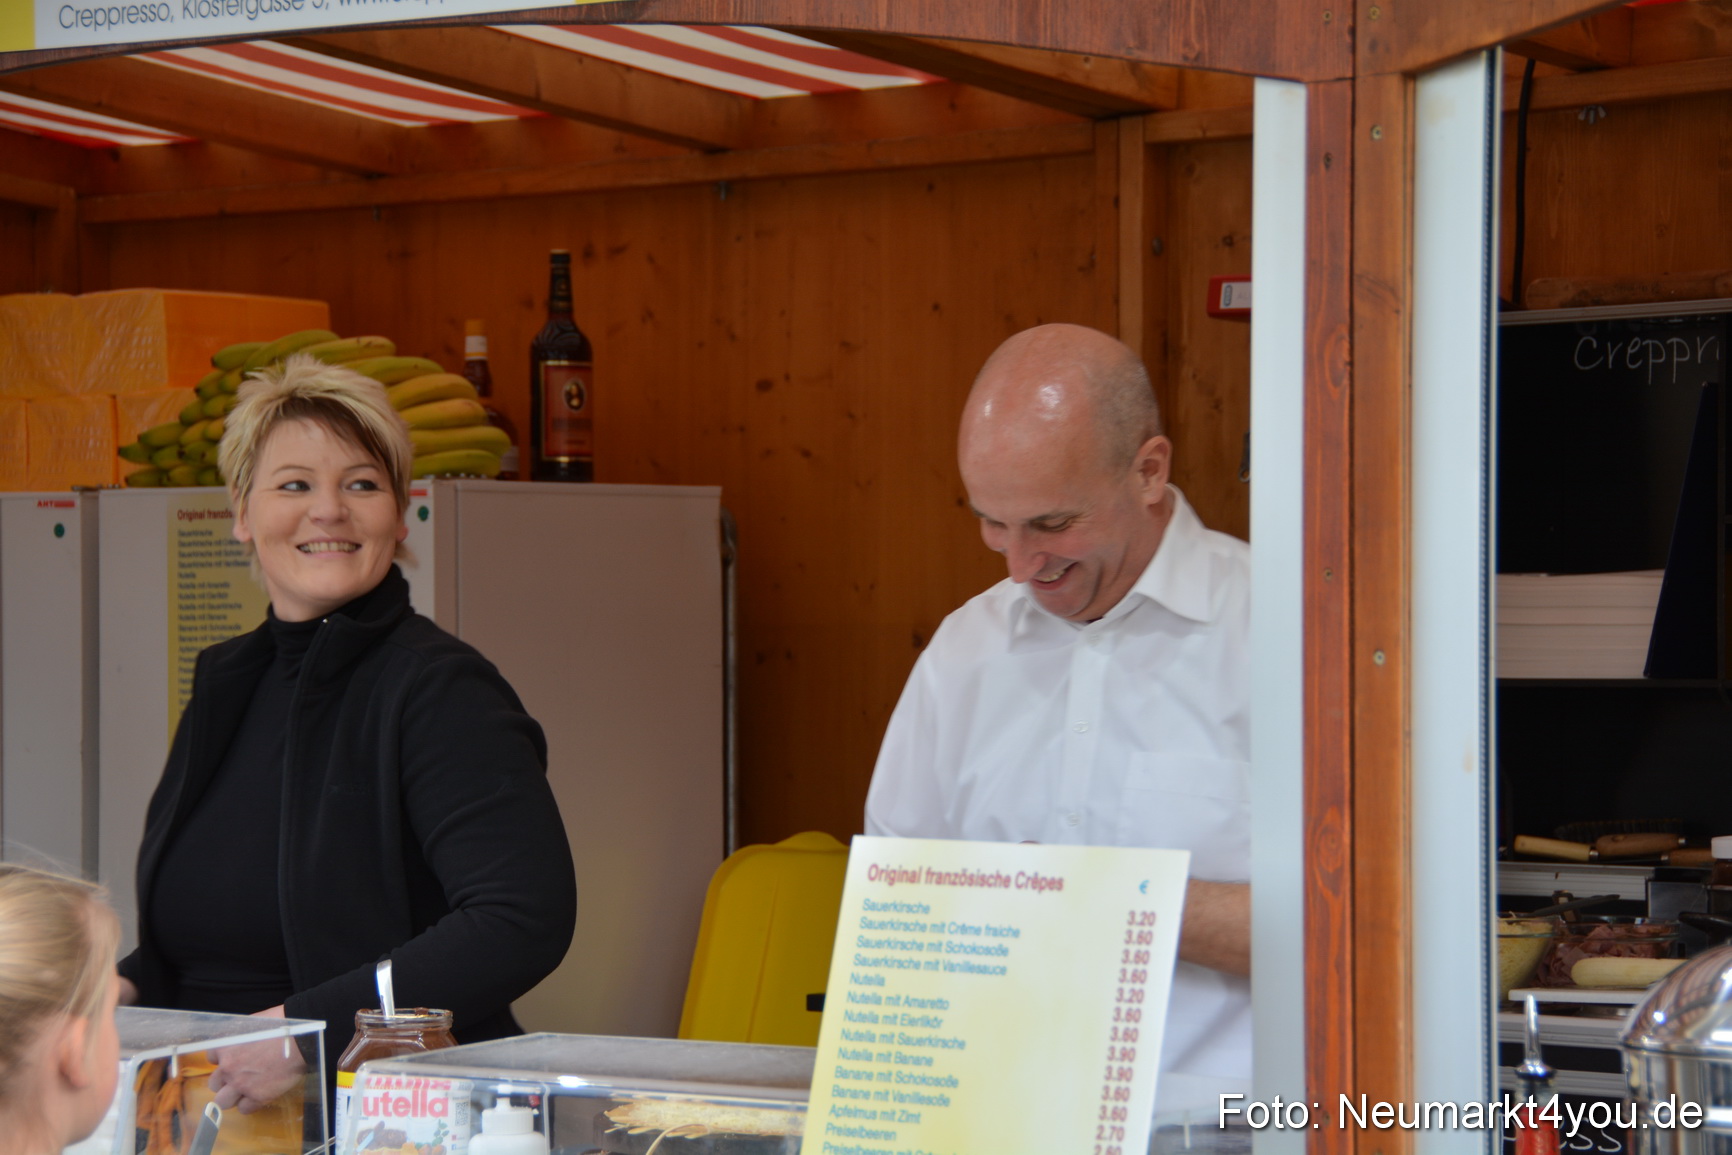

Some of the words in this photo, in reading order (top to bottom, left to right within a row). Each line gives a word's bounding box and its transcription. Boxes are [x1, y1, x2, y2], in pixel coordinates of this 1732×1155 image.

[58, 2, 174, 32] Creppresso,
[867, 863, 922, 887] Original
[925, 866, 1011, 889] französische
[862, 898, 931, 915] Sauerkirsche
[1127, 910, 1157, 927] 3.20
[859, 916, 928, 933] Sauerkirsche
[929, 921, 946, 934] mit
[1124, 929, 1153, 946] 3.60
[856, 935, 924, 952] Sauerkirsche
[926, 940, 943, 953] mit
[945, 940, 1009, 957] Schokosoße
[1121, 949, 1150, 965] 3.60
[853, 953, 921, 970] Sauerkirsche
[923, 958, 940, 971] mit
[942, 959, 1007, 976] Vanillesauce
[1118, 968, 1147, 984] 3.60
[849, 972, 886, 987] Nutella
[1115, 987, 1145, 1004] 3.20
[846, 991, 883, 1005] Nutella
[884, 994, 901, 1006] mit
[902, 995, 950, 1010] Amaretto
[1112, 1006, 1142, 1023] 3.60
[843, 1009, 879, 1024] Nutella
[881, 1013, 898, 1025] mit
[900, 1013, 943, 1029] Eierlikör
[1110, 1025, 1139, 1043] 3.60
[840, 1028, 876, 1043] Nutella
[879, 1033, 895, 1044] mit
[897, 1032, 966, 1050] Sauerkirsche
[1107, 1045, 1136, 1063] 3.90
[837, 1047, 873, 1062] Nutella
[875, 1051, 892, 1063] mit
[894, 1051, 934, 1066] Banane
[1104, 1064, 1133, 1082] 3.90
[831, 1084, 871, 1100] Banane
[873, 1089, 890, 1102] mit
[834, 1065, 874, 1081] Banane
[876, 1070, 893, 1082] mit
[894, 1070, 959, 1088] Schokosoße
[1101, 1084, 1130, 1102] 3.60
[347, 1090, 449, 1118] utella
[825, 1122, 897, 1141] Preiselbeeren
[828, 1104, 877, 1121] Apfelmus
[879, 1109, 896, 1121] mit
[897, 1109, 921, 1124] Zimt
[1095, 1124, 1125, 1143] 2.70
